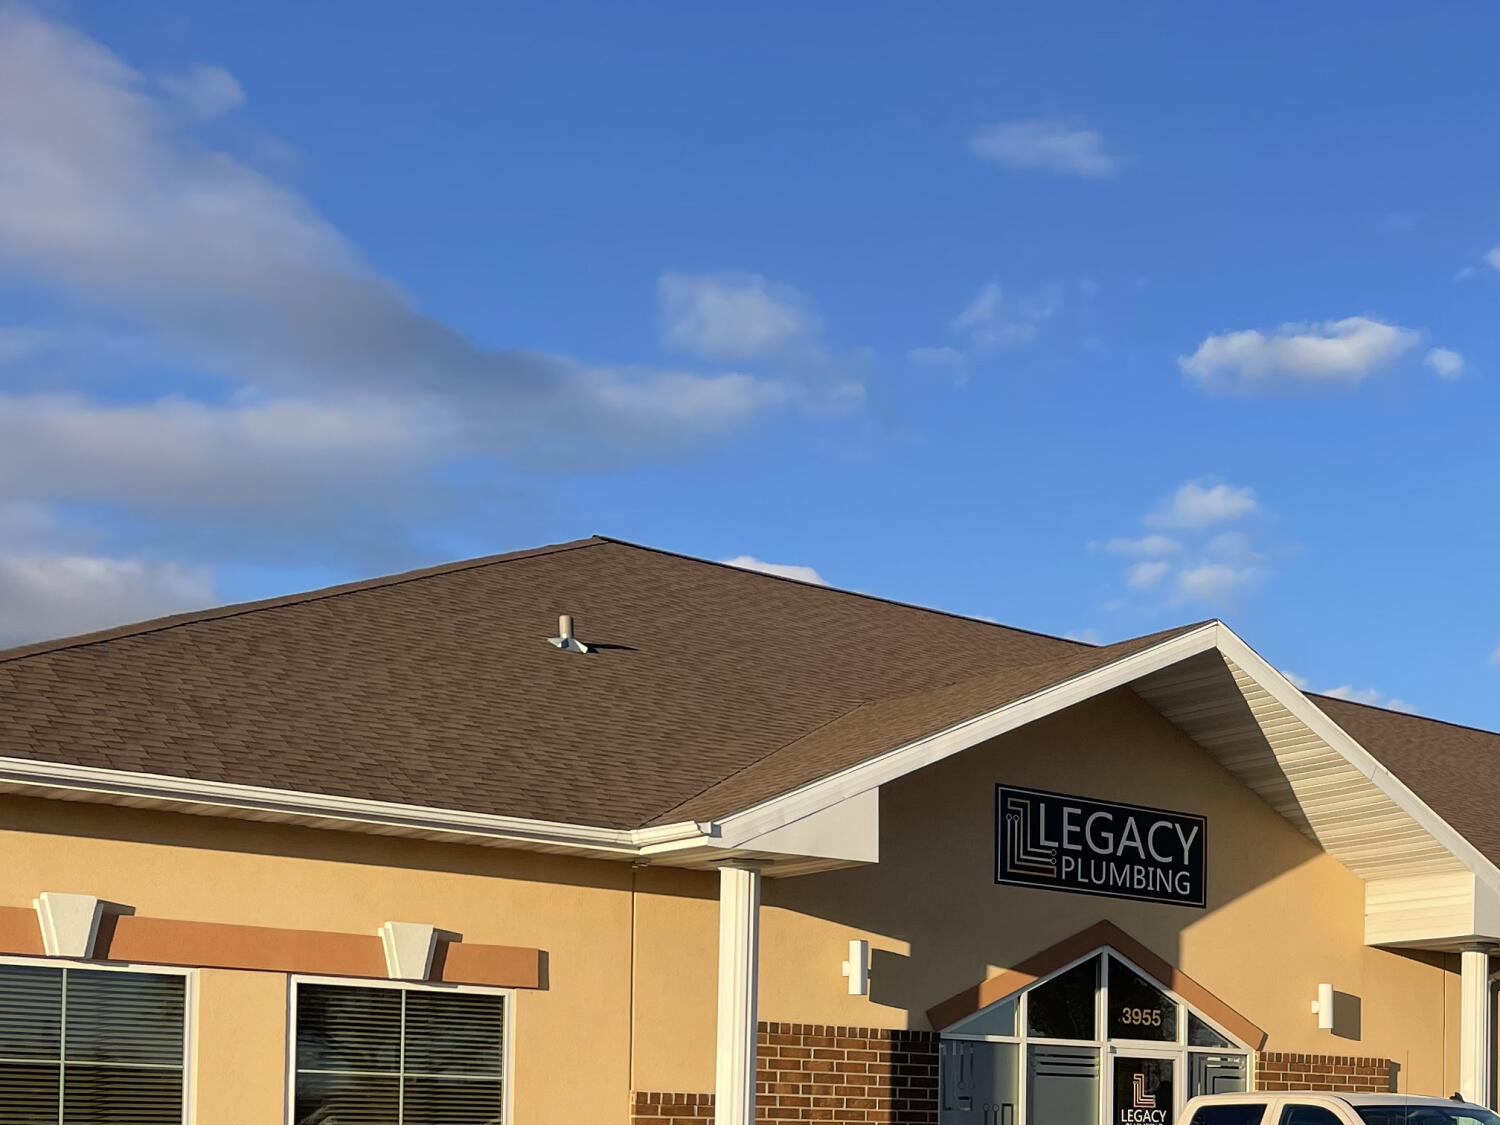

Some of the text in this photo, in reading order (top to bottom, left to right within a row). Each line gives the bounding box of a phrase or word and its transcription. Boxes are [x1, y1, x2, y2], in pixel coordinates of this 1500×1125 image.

[1039, 803, 1199, 865] LEGACY
[1062, 855, 1191, 895] PLUMBING
[1122, 1007, 1161, 1026] 3955
[1121, 1109, 1167, 1123] LEGACY
